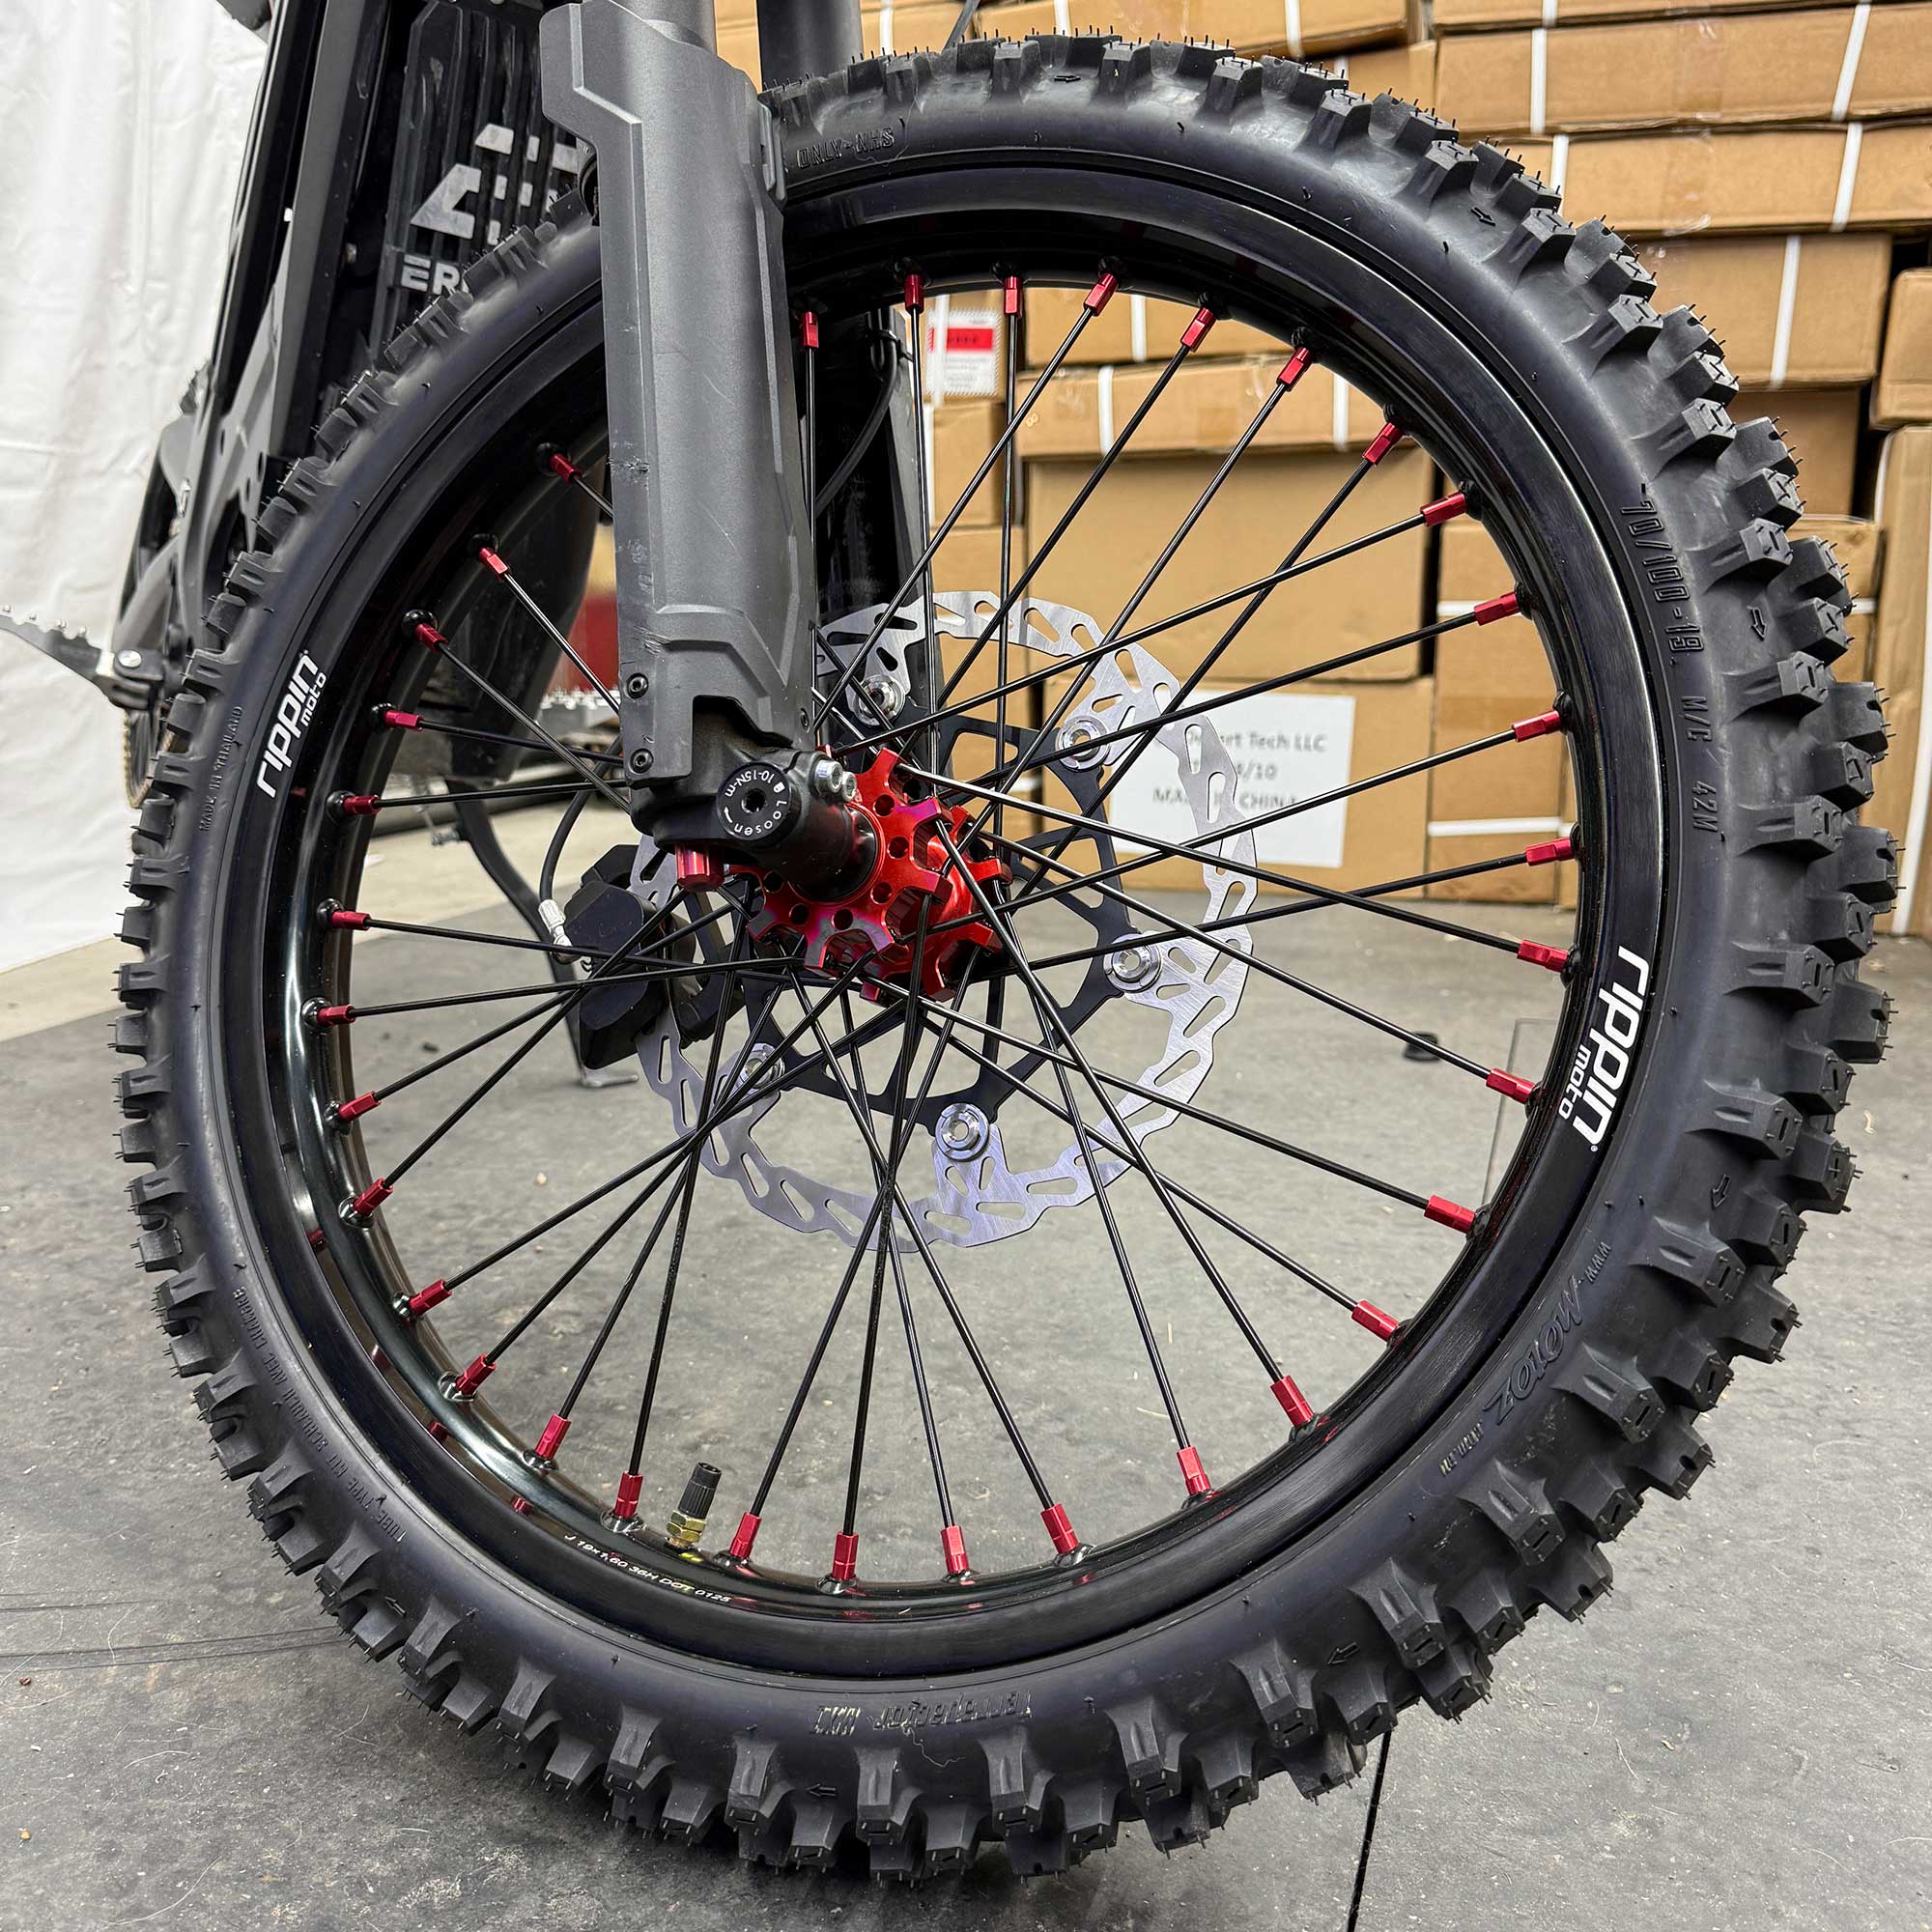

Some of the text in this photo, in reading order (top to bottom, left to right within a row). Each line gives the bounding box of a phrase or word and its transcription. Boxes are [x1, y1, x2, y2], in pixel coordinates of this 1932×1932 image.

[256, 654, 319, 799] rippin
[300, 671, 327, 727] moto
[199, 705, 243, 832] MADE IN THAILAND
[1250, 729, 1291, 752] Tech
[1294, 733, 1327, 753] LLC
[733, 800, 787, 837] Loosen
[1691, 780, 1719, 833] 42M
[1572, 945, 1650, 1146] rippin
[1558, 1043, 1592, 1121] moto
[629, 1565, 659, 1580] 36H
[659, 1577, 695, 1592] DOT
[695, 1589, 732, 1603] 0125
